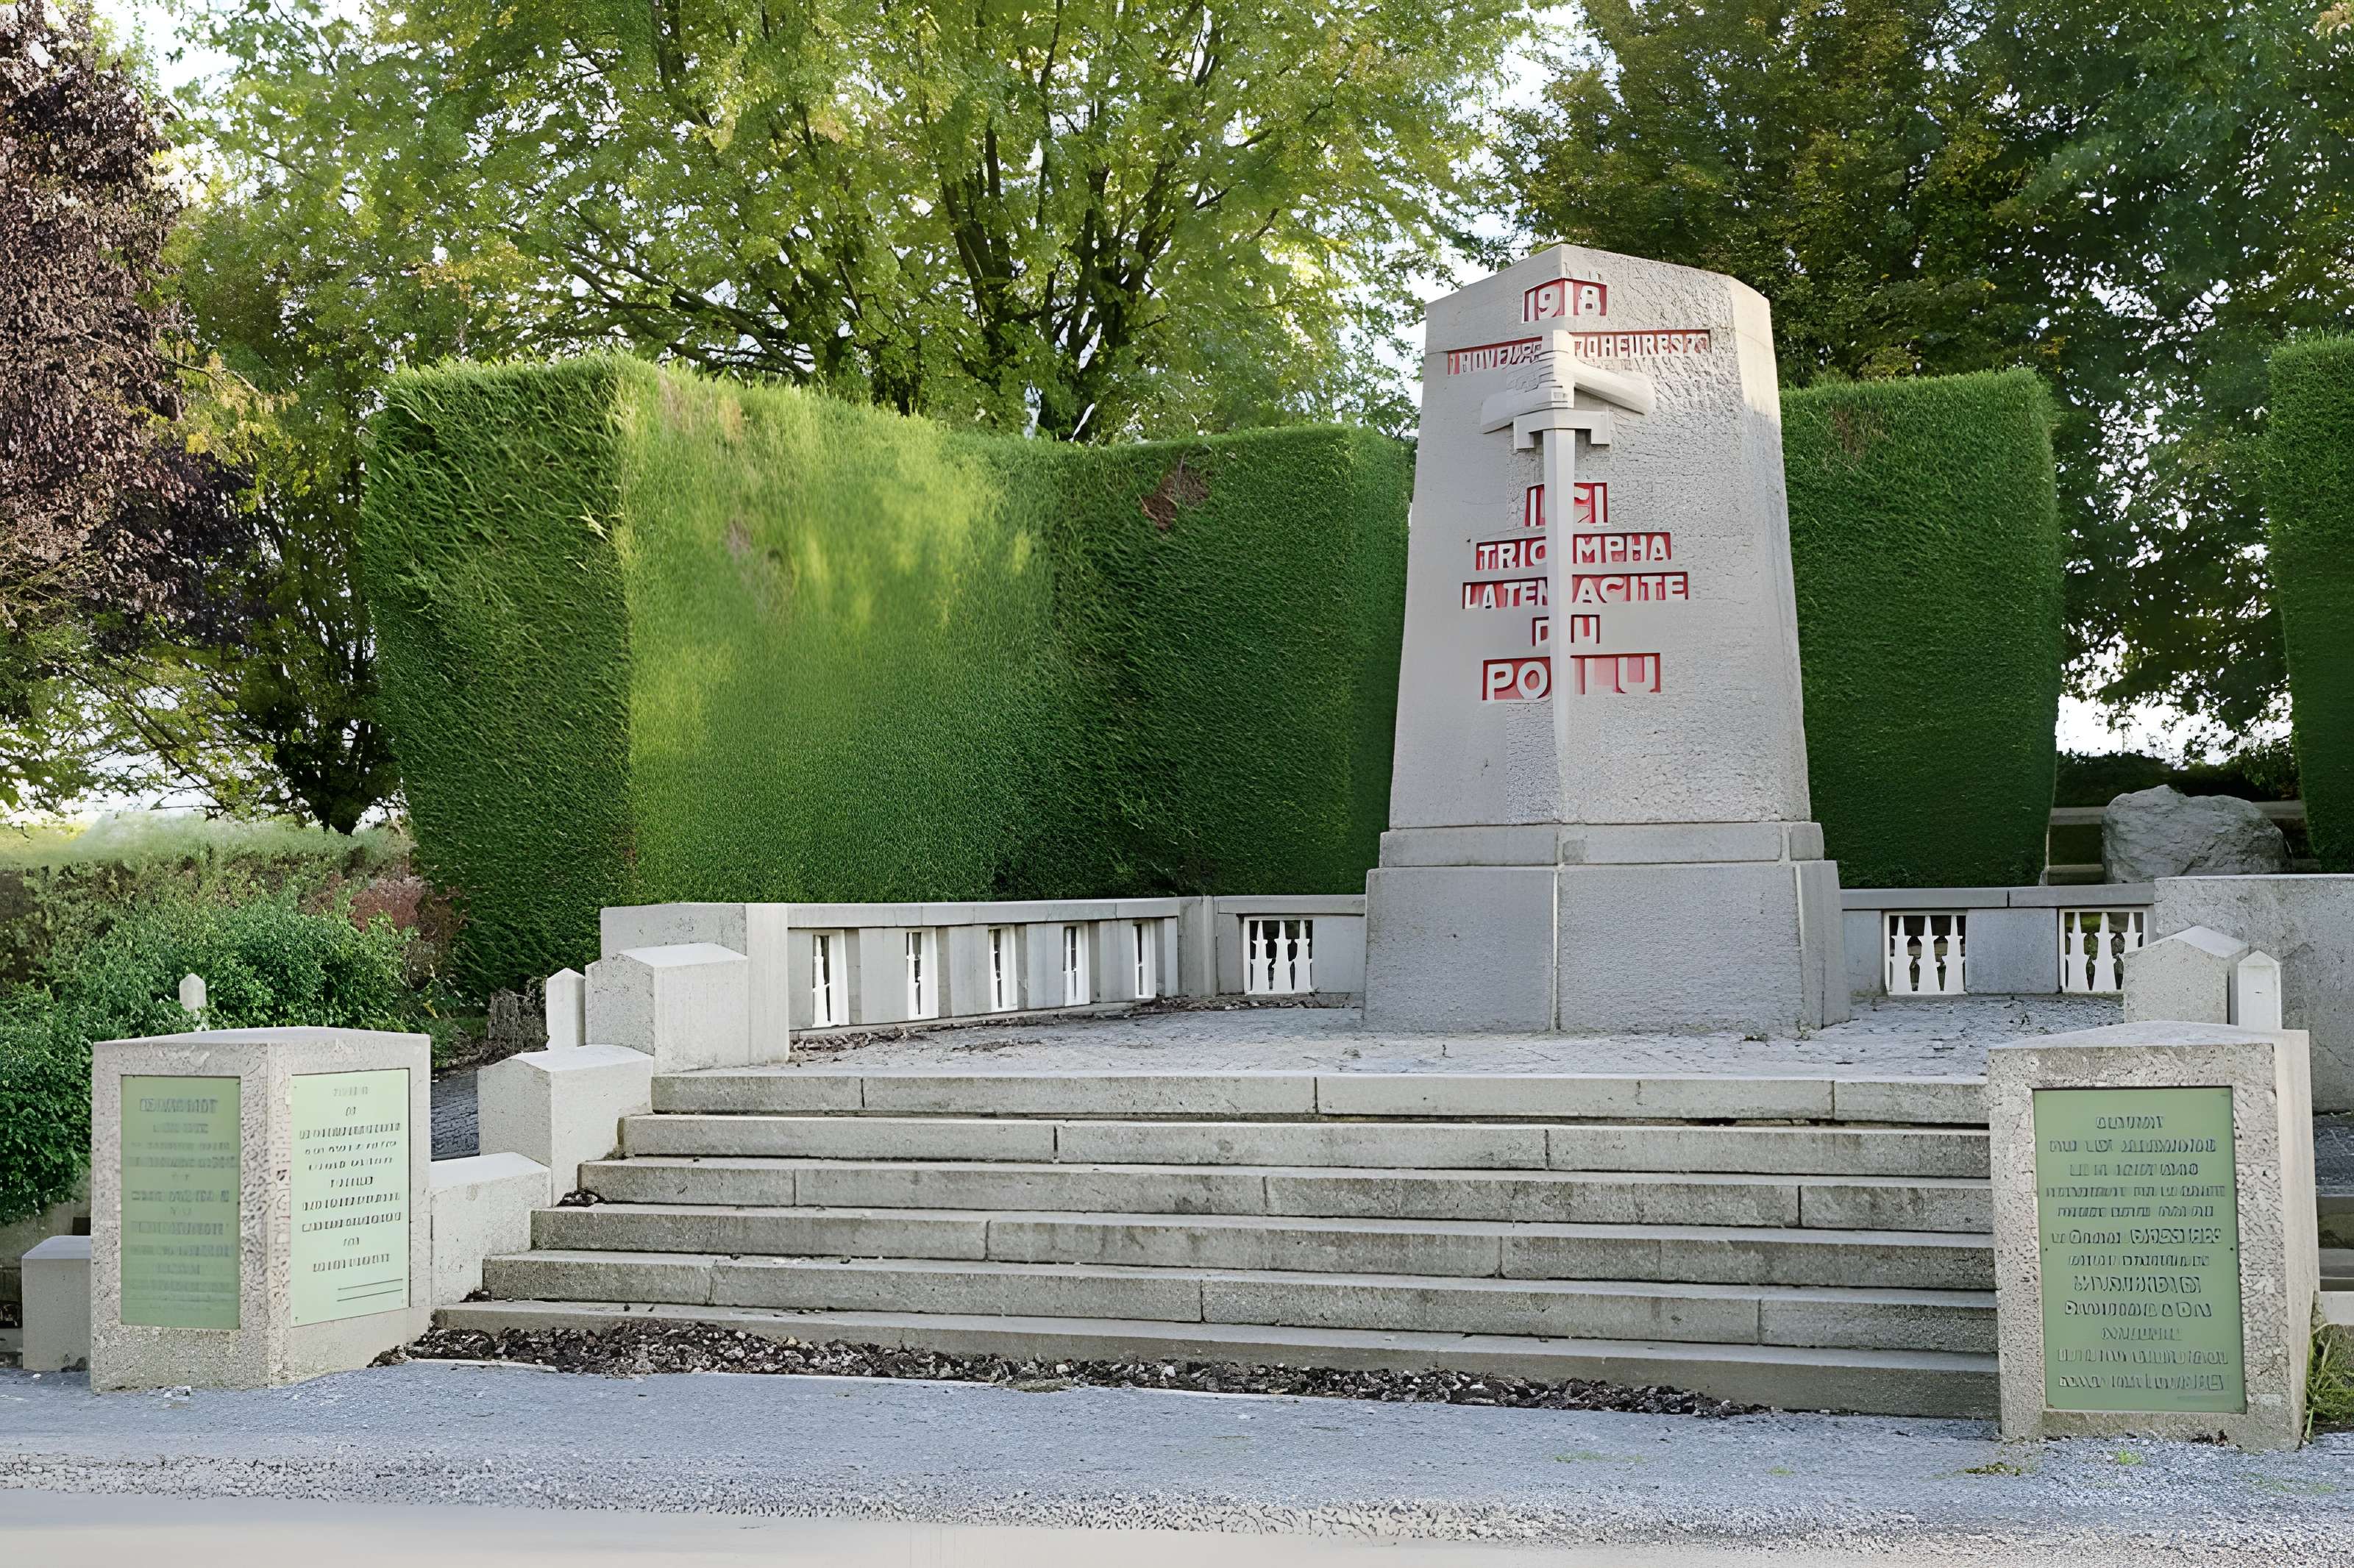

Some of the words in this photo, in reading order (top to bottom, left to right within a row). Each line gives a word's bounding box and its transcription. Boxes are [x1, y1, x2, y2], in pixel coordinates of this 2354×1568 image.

[1526, 279, 1603, 322] 1918
[1477, 534, 1668, 569] TRIOMPHA
[1485, 655, 1657, 701] POLU
